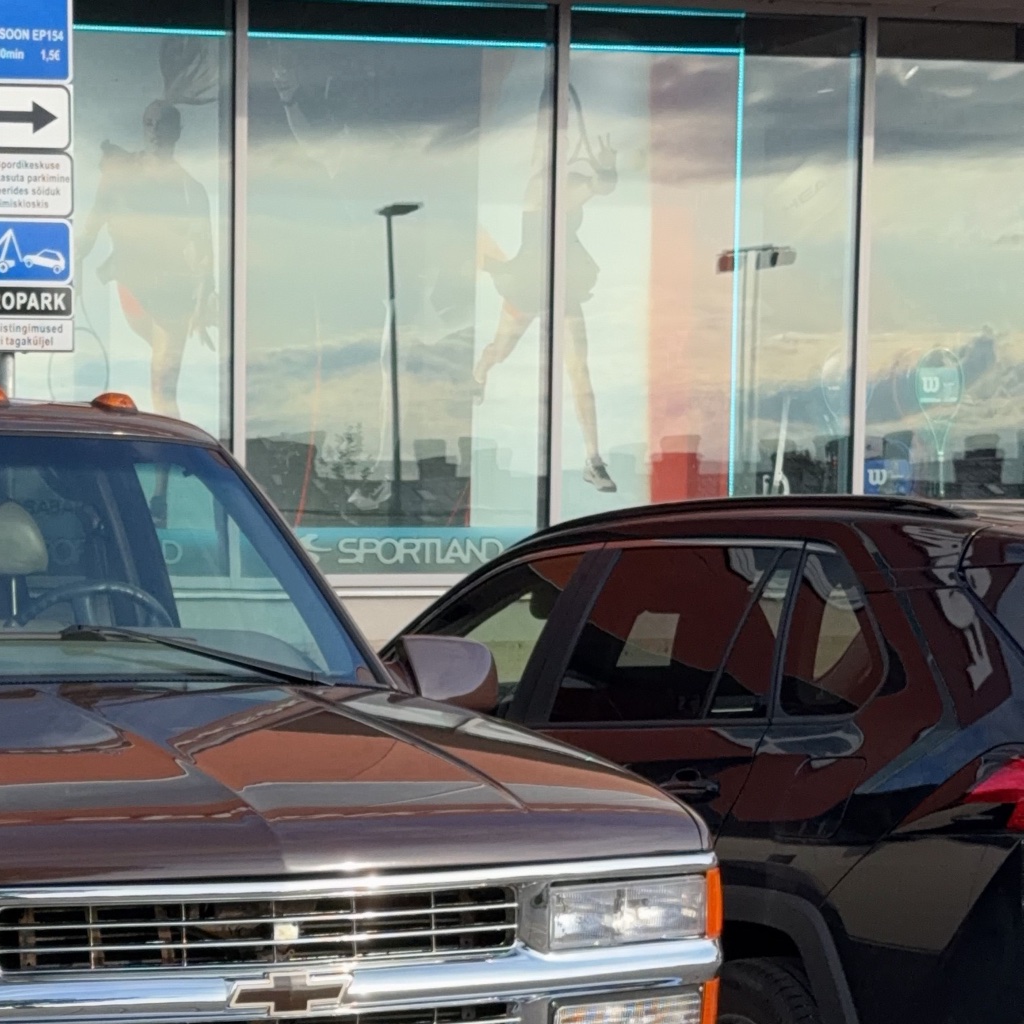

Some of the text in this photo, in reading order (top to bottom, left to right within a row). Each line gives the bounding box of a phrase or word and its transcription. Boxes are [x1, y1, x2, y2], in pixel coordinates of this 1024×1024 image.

[32, 29, 64, 41] EP154
[27, 174, 70, 184] parkimine
[5, 336, 54, 348] tagaküljel
[338, 537, 503, 565] SPORTLAND
